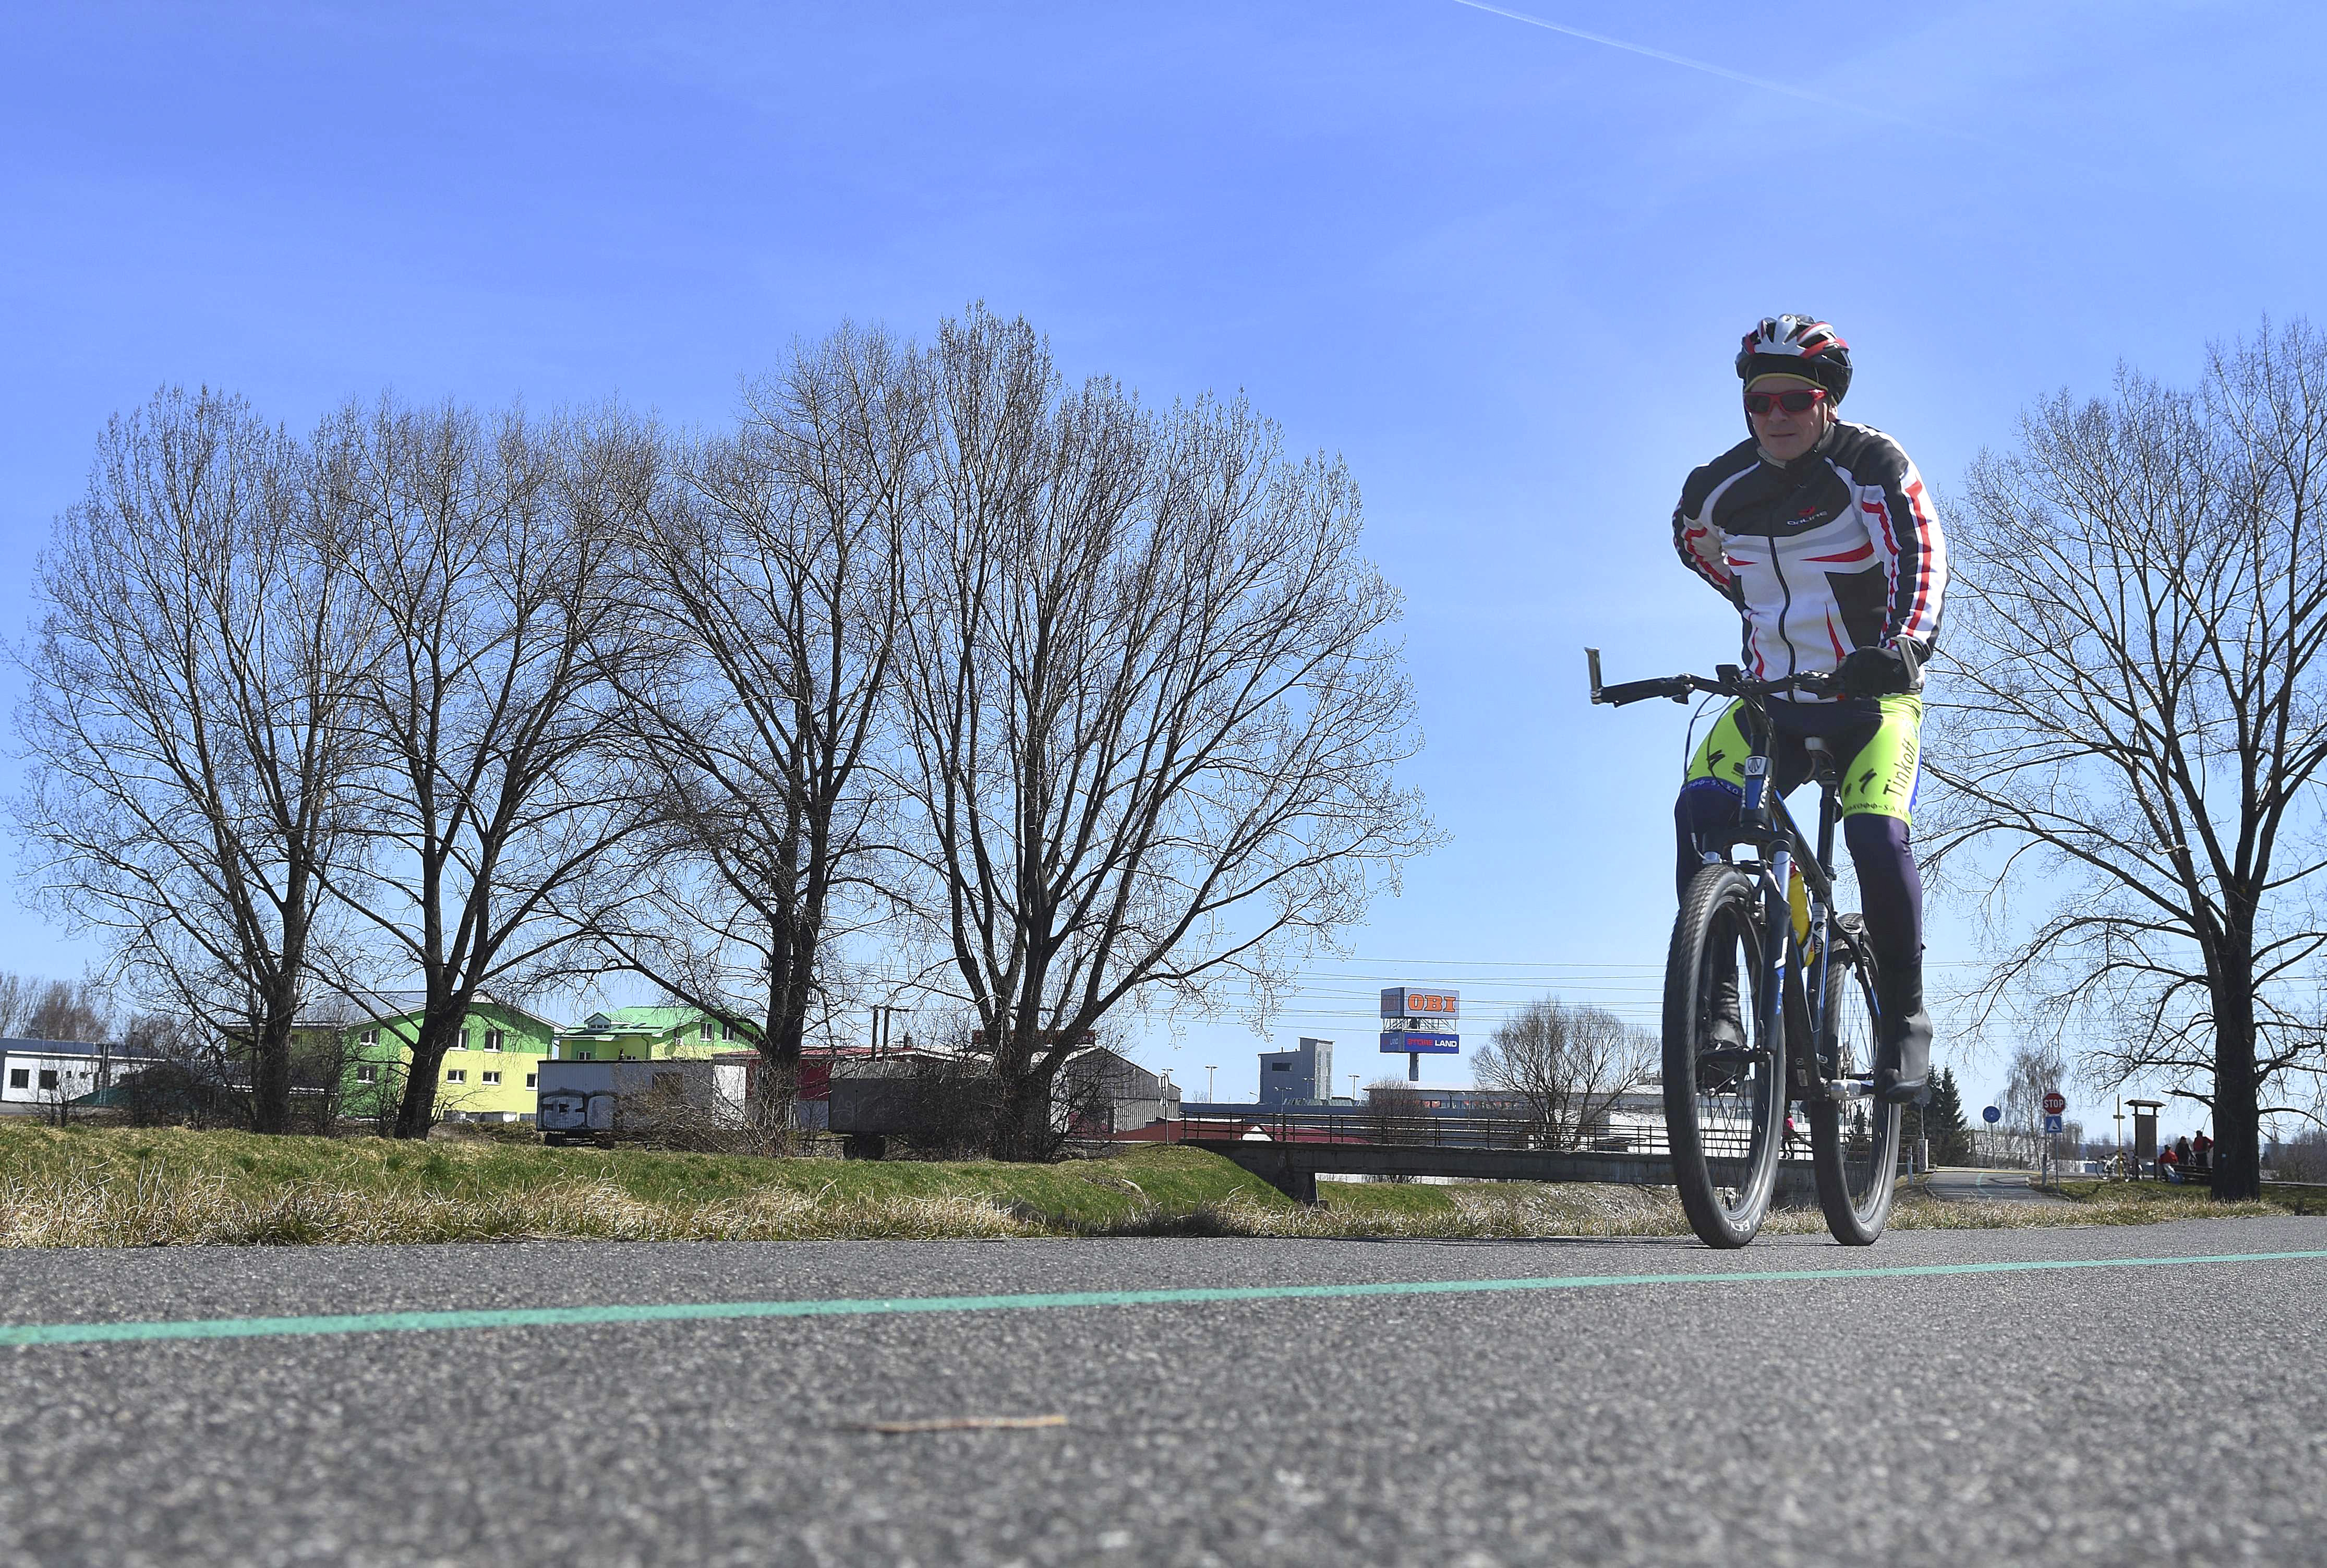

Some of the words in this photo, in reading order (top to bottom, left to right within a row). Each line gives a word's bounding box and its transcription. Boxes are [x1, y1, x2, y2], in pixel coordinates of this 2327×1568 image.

[1882, 738, 1916, 797] Tinkoff
[1407, 993, 1456, 1012] OBI
[2044, 1099, 2064, 1108] STOP
